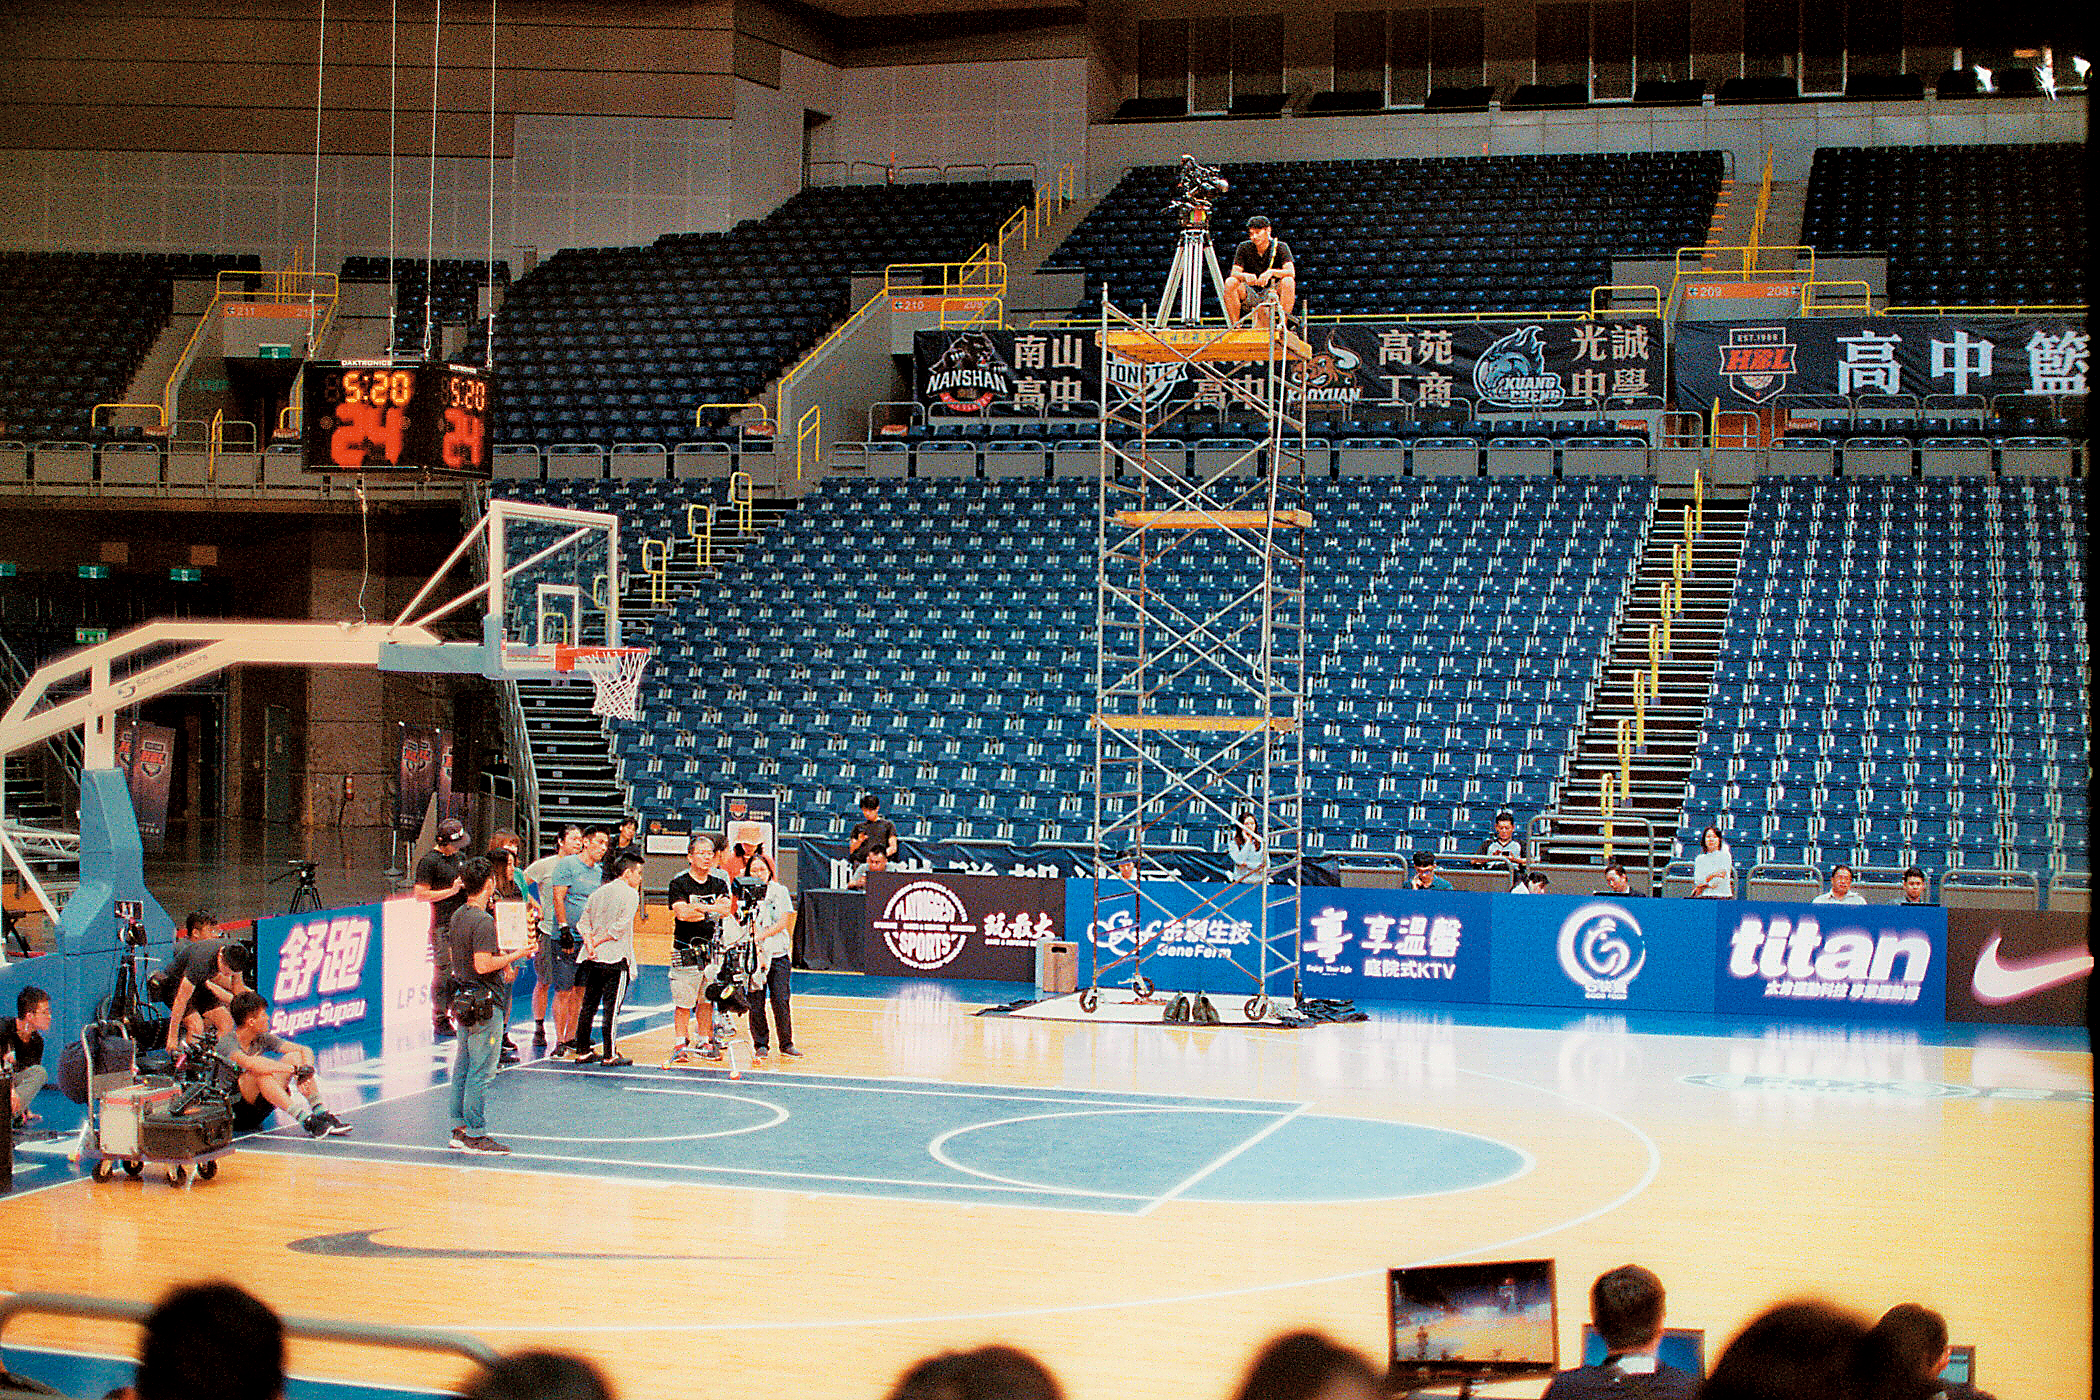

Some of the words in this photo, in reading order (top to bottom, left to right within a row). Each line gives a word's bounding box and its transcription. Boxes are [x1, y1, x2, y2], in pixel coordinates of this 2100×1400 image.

[1013, 334, 1083, 370] 南山
[1377, 329, 1455, 366] 高苑
[1571, 324, 1650, 362] 光誠
[1725, 348, 1791, 371] HBL
[341, 359, 393, 367] DAKTRONICS
[926, 368, 1009, 395] NANSHAN
[343, 370, 410, 405] 5:20
[450, 376, 486, 411] 5:20
[1012, 375, 1083, 412] 高中
[1377, 371, 1454, 409] 工商
[1571, 368, 1651, 406] 中學
[331, 402, 404, 469] 24
[442, 407, 487, 468] 24
[273, 917, 371, 1001] 舒跑
[898, 930, 952, 962] SPORTS
[1730, 919, 1931, 982] titan
[270, 1008, 320, 1036] Super
[319, 999, 367, 1026] Supau
